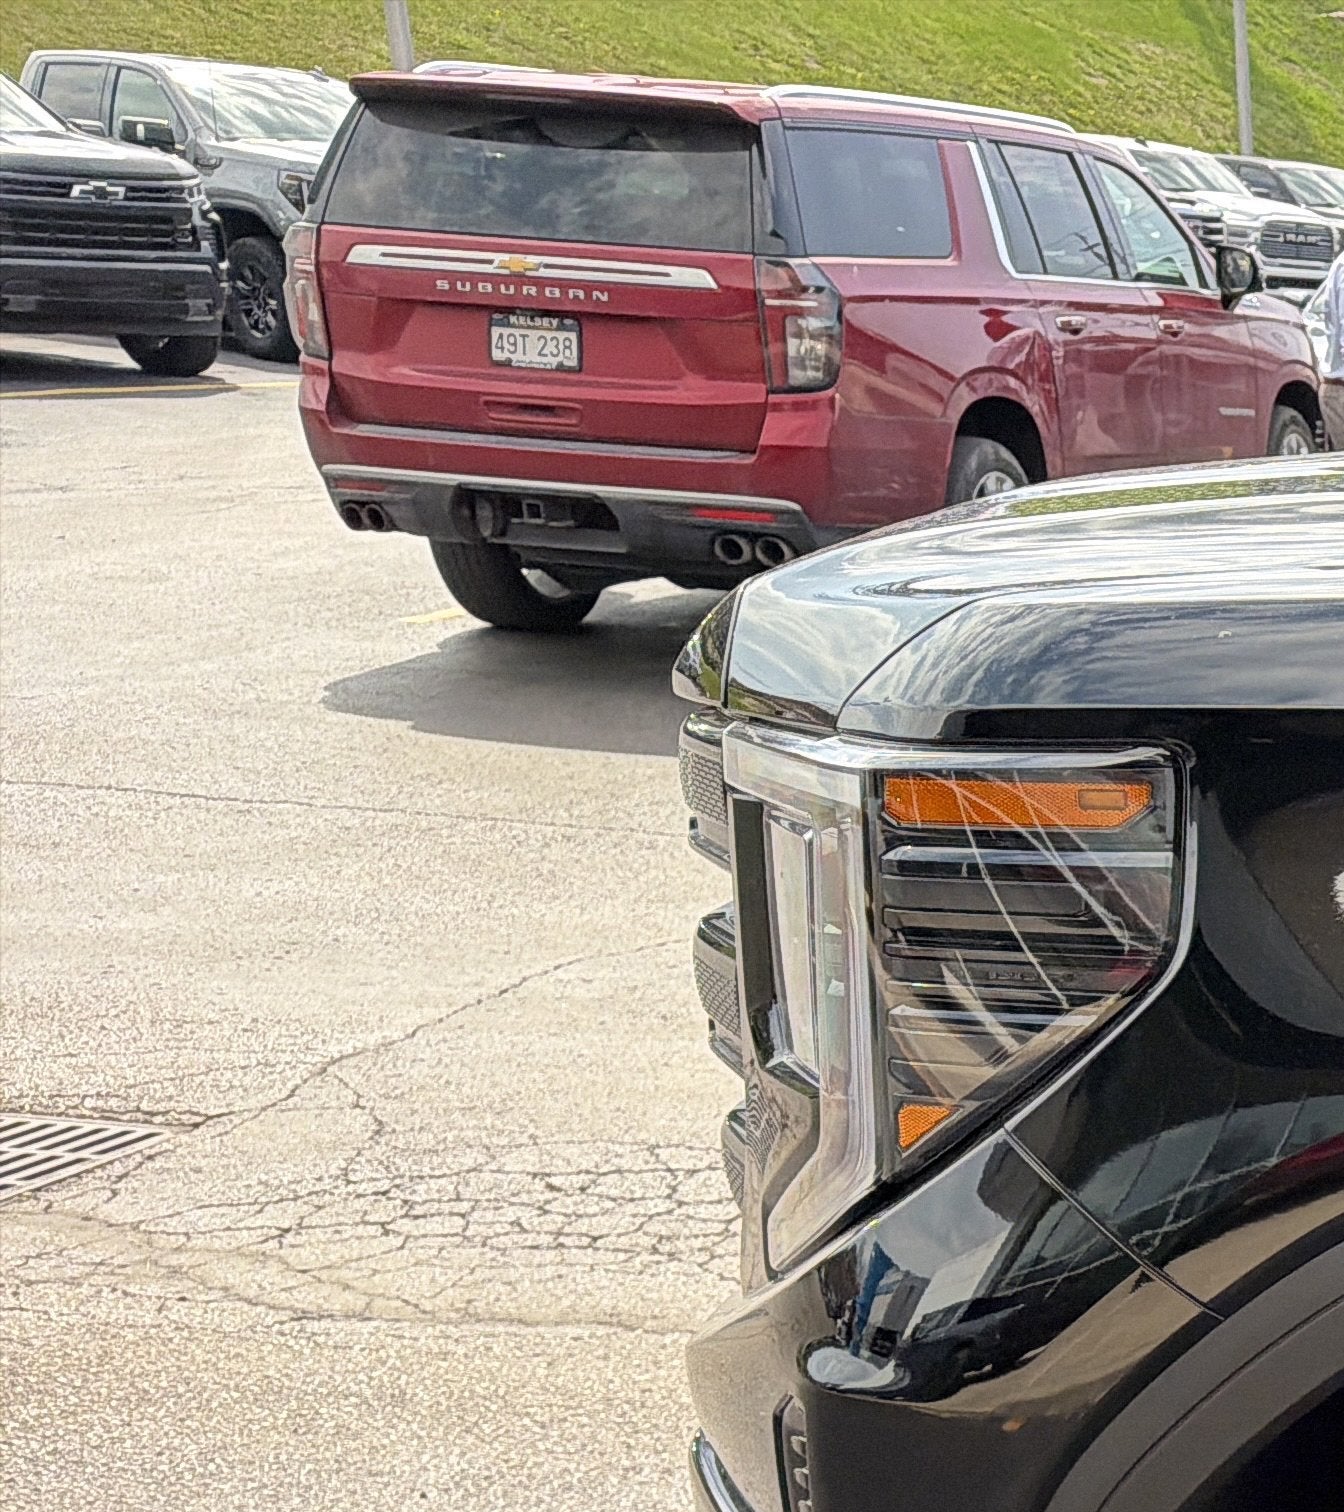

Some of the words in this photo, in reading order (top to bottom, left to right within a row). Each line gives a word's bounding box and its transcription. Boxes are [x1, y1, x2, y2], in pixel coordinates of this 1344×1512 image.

[435, 279, 609, 302] SUBURBAN
[509, 314, 559, 328] KELSEY
[495, 332, 529, 356] 49T
[537, 335, 573, 358] 238
